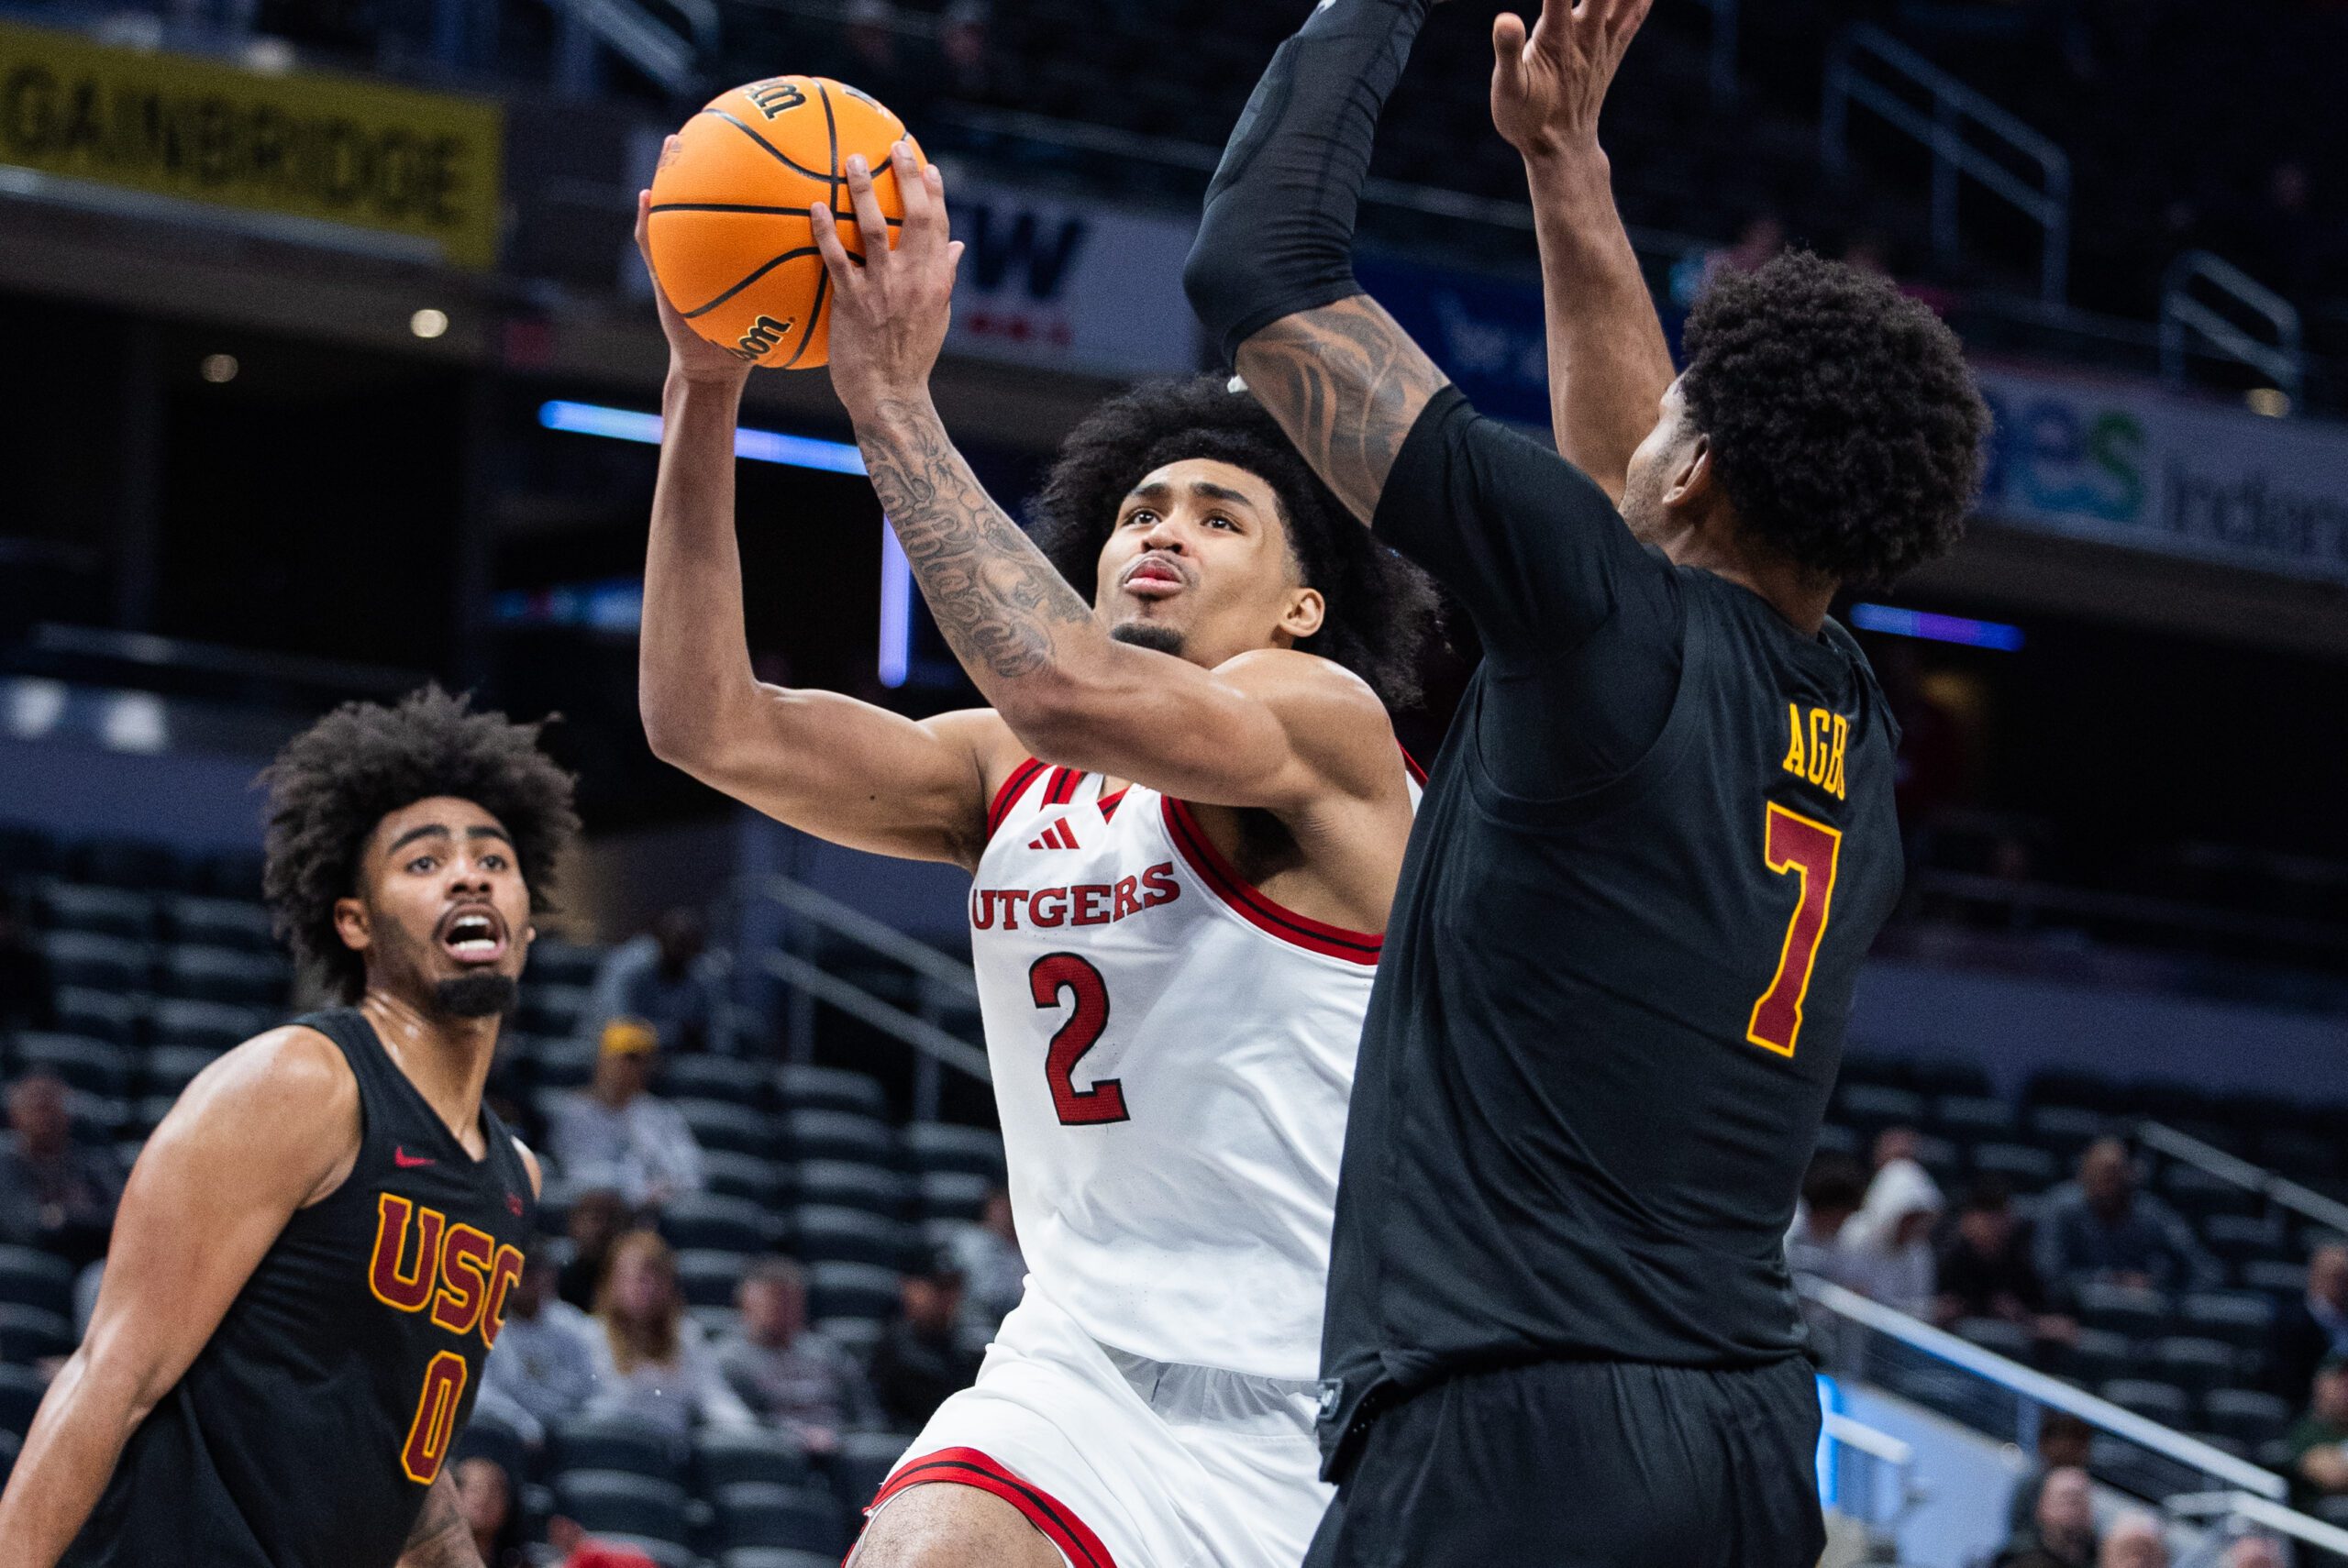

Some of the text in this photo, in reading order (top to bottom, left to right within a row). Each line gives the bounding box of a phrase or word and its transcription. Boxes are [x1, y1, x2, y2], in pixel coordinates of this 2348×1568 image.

[1782, 702, 1847, 801] AGB
[1746, 801, 1842, 1058] 7
[1028, 951, 1131, 1126] 2
[369, 1192, 525, 1350] USC
[400, 1350, 468, 1485] 0
